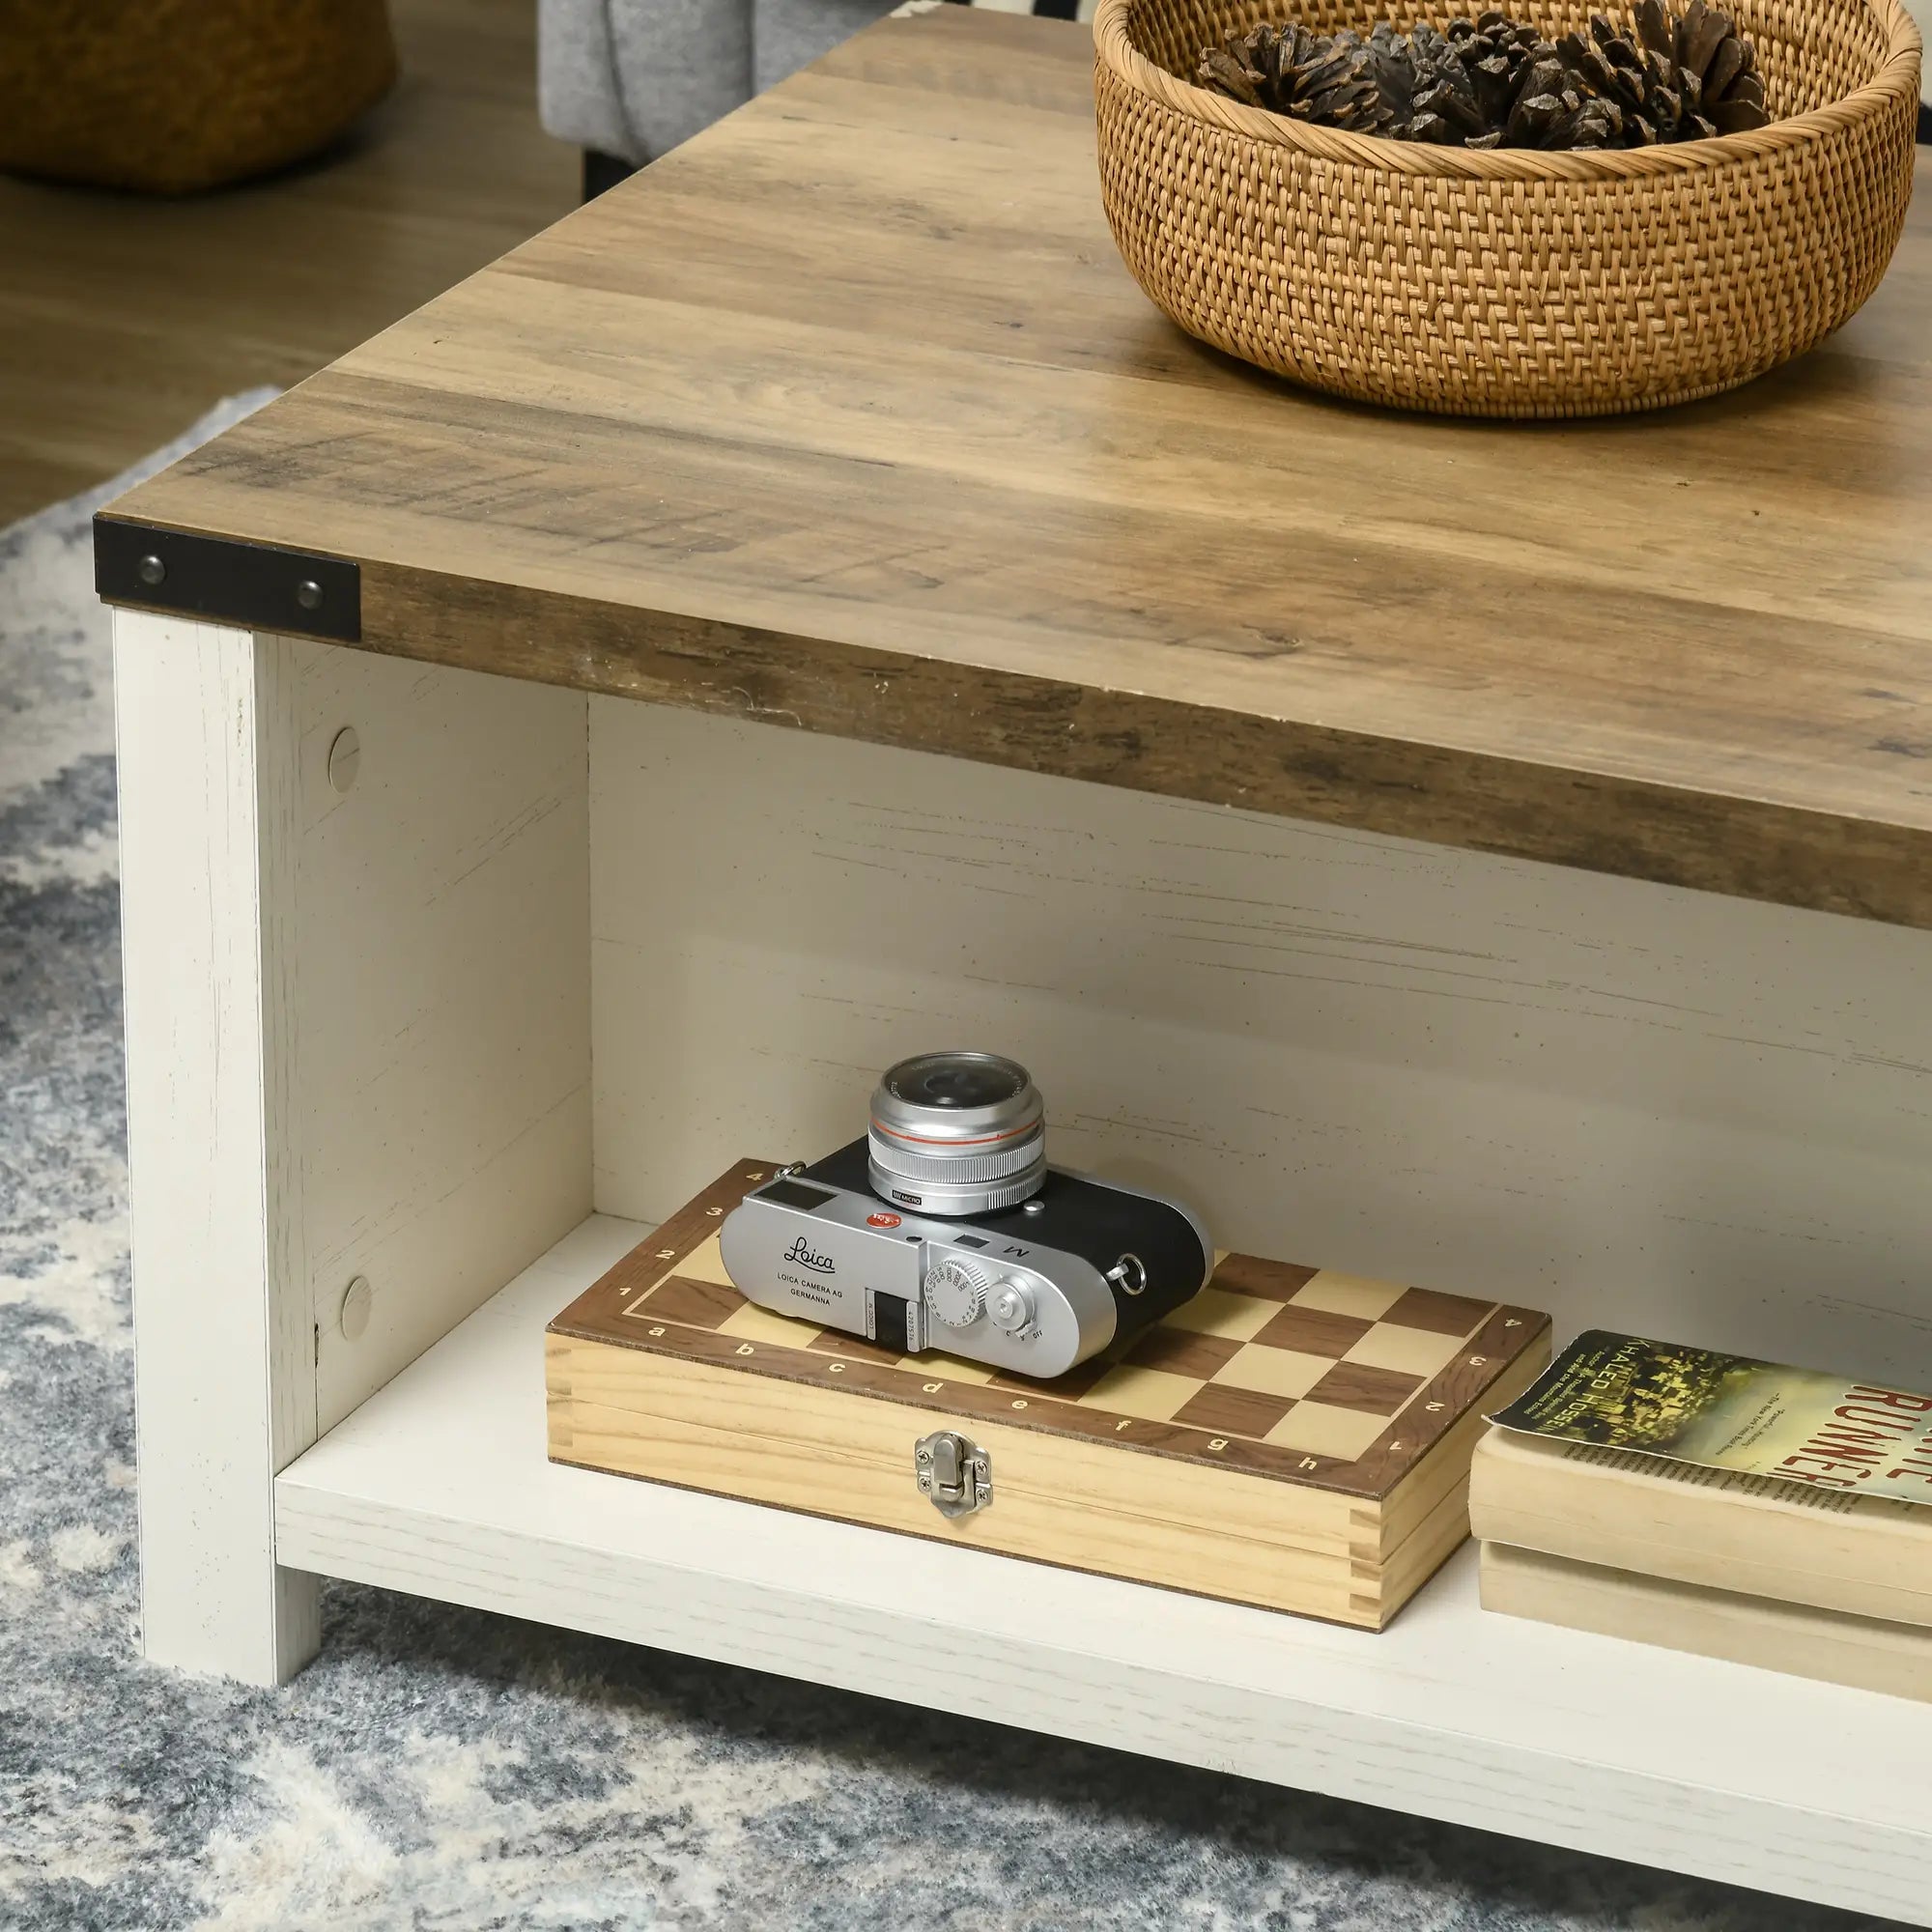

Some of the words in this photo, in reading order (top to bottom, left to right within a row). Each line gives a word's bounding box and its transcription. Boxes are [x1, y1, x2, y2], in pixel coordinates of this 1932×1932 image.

[747, 1173, 763, 1182] 4
[706, 1207, 723, 1216] 3
[656, 1250, 674, 1260] 2
[777, 1272, 799, 1285] LOICA
[801, 1280, 831, 1295] CAMERA
[832, 1290, 843, 1298] AG
[619, 1287, 632, 1296] 1
[790, 1289, 831, 1306] GERMANNA
[1505, 1319, 1522, 1327] 4
[648, 1326, 667, 1337] a
[736, 1343, 754, 1355] b
[1469, 1356, 1487, 1367] 3
[1590, 1338, 1650, 1389] KHALED
[829, 1363, 845, 1373] c
[923, 1381, 944, 1394] d
[1011, 1400, 1029, 1409] e
[1426, 1401, 1444, 1412] 2
[1114, 1420, 1132, 1432] f
[1766, 1385, 1932, 1487] RUNNER
[1208, 1437, 1228, 1452] g
[1389, 1442, 1402, 1452] 1
[1298, 1457, 1317, 1470] h
